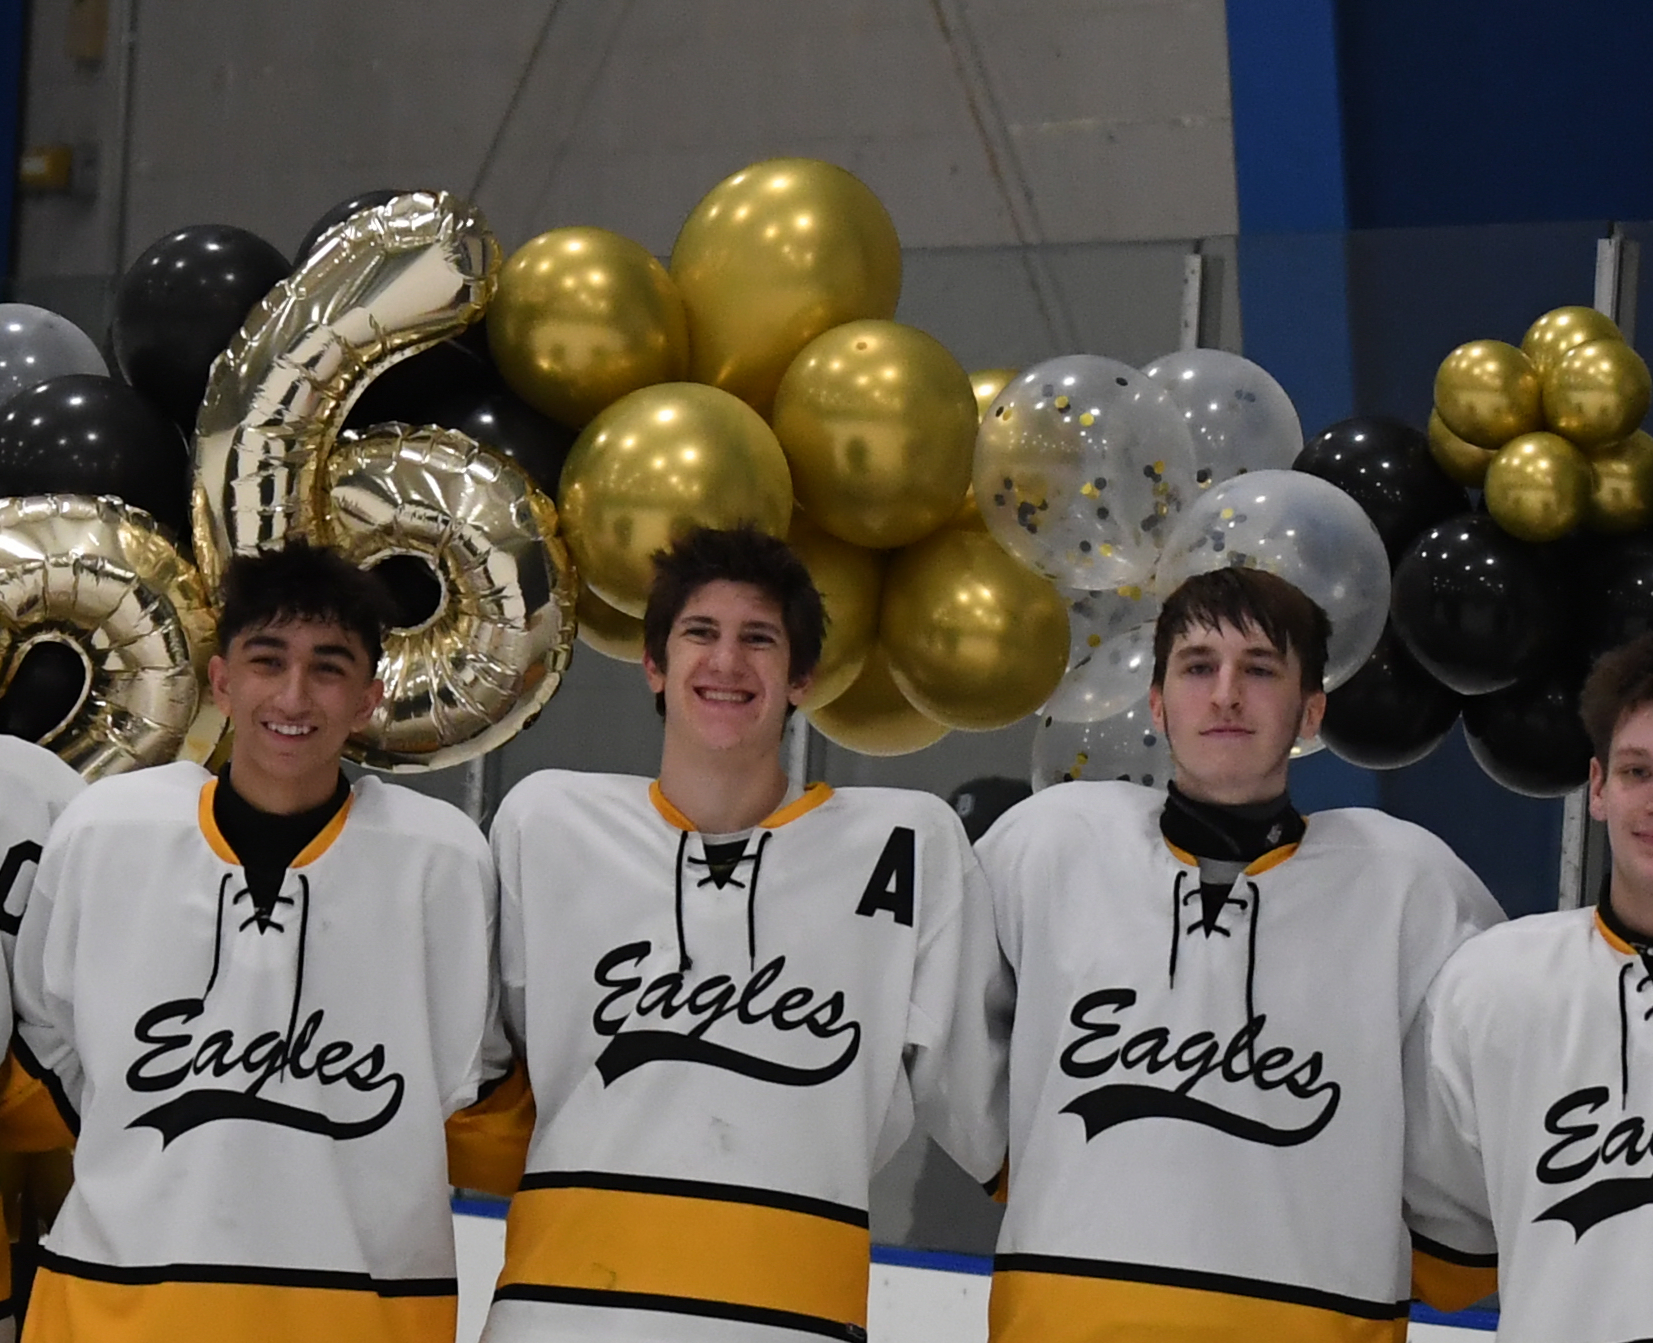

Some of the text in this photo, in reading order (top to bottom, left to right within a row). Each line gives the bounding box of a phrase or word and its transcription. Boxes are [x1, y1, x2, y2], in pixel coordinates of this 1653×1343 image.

[855, 826, 915, 927] A
[593, 940, 852, 1038] Eagles
[125, 998, 390, 1094] Eagles
[1059, 987, 1328, 1096] Eagles
